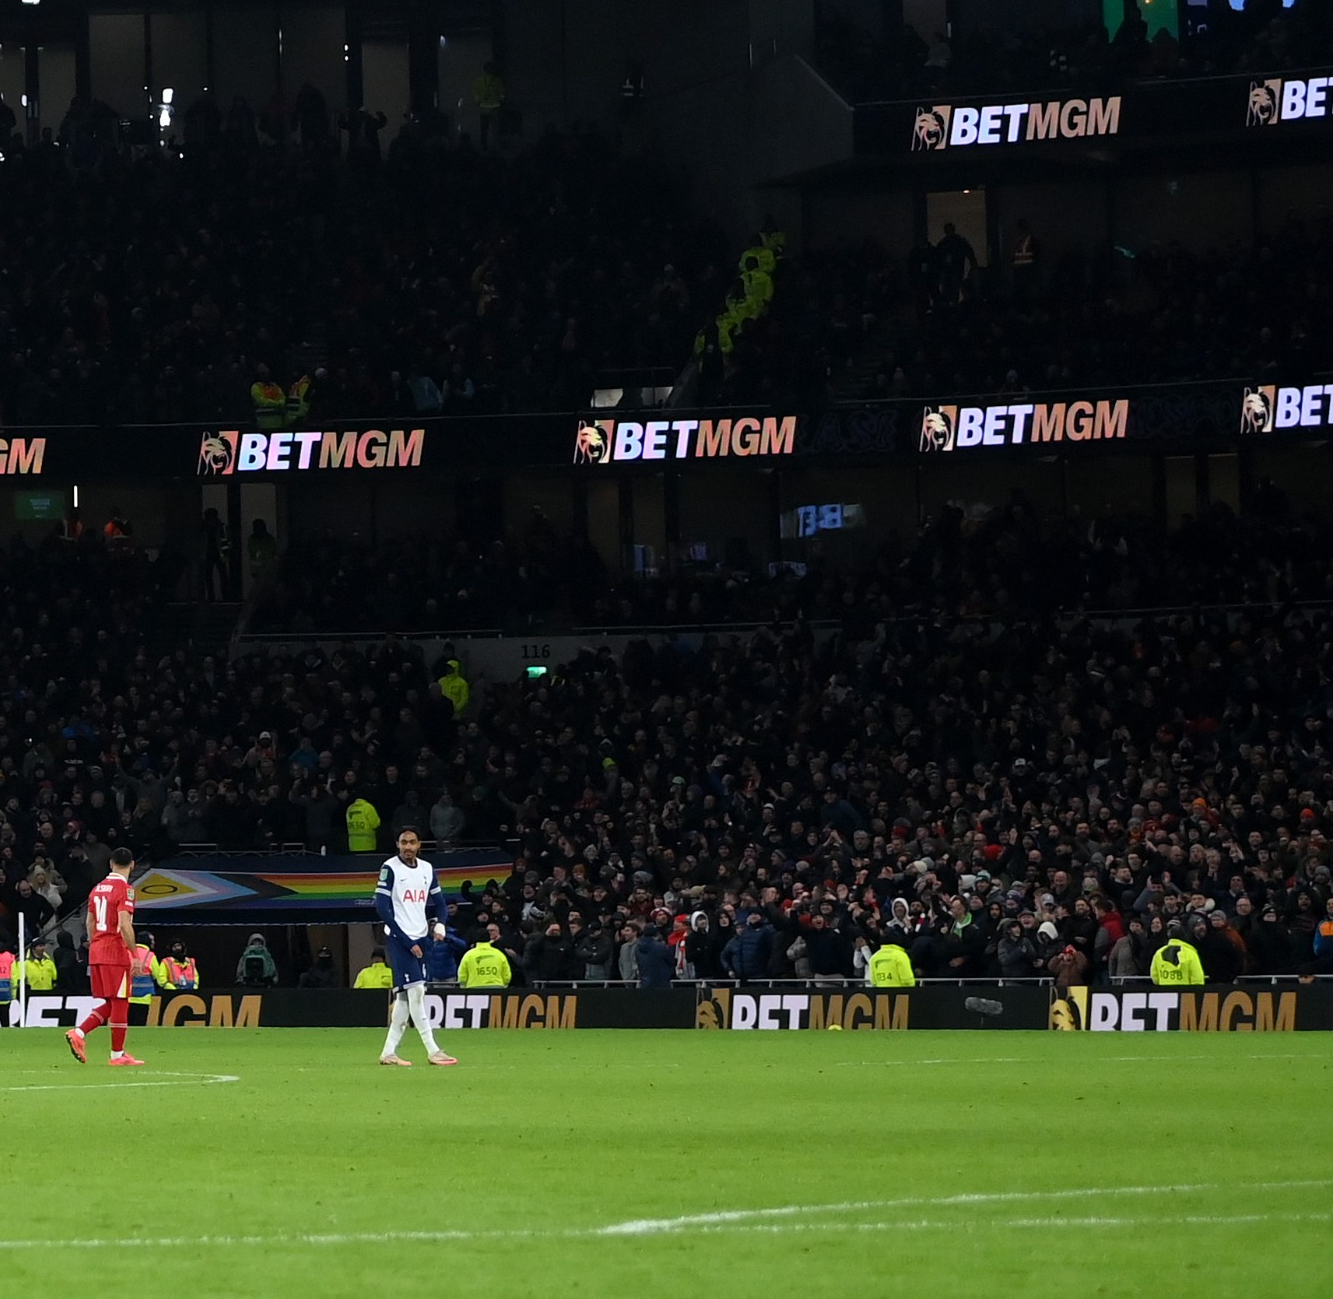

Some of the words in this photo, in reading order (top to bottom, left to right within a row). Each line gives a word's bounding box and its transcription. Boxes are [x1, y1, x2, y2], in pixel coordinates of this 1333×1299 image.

[1281, 77, 1333, 119] BE
[950, 97, 1120, 145] BETMGM
[614, 417, 796, 460] BETMGM
[957, 400, 1128, 446] BETMGM
[238, 430, 424, 470] BETMGM
[403, 889, 425, 902] AIA
